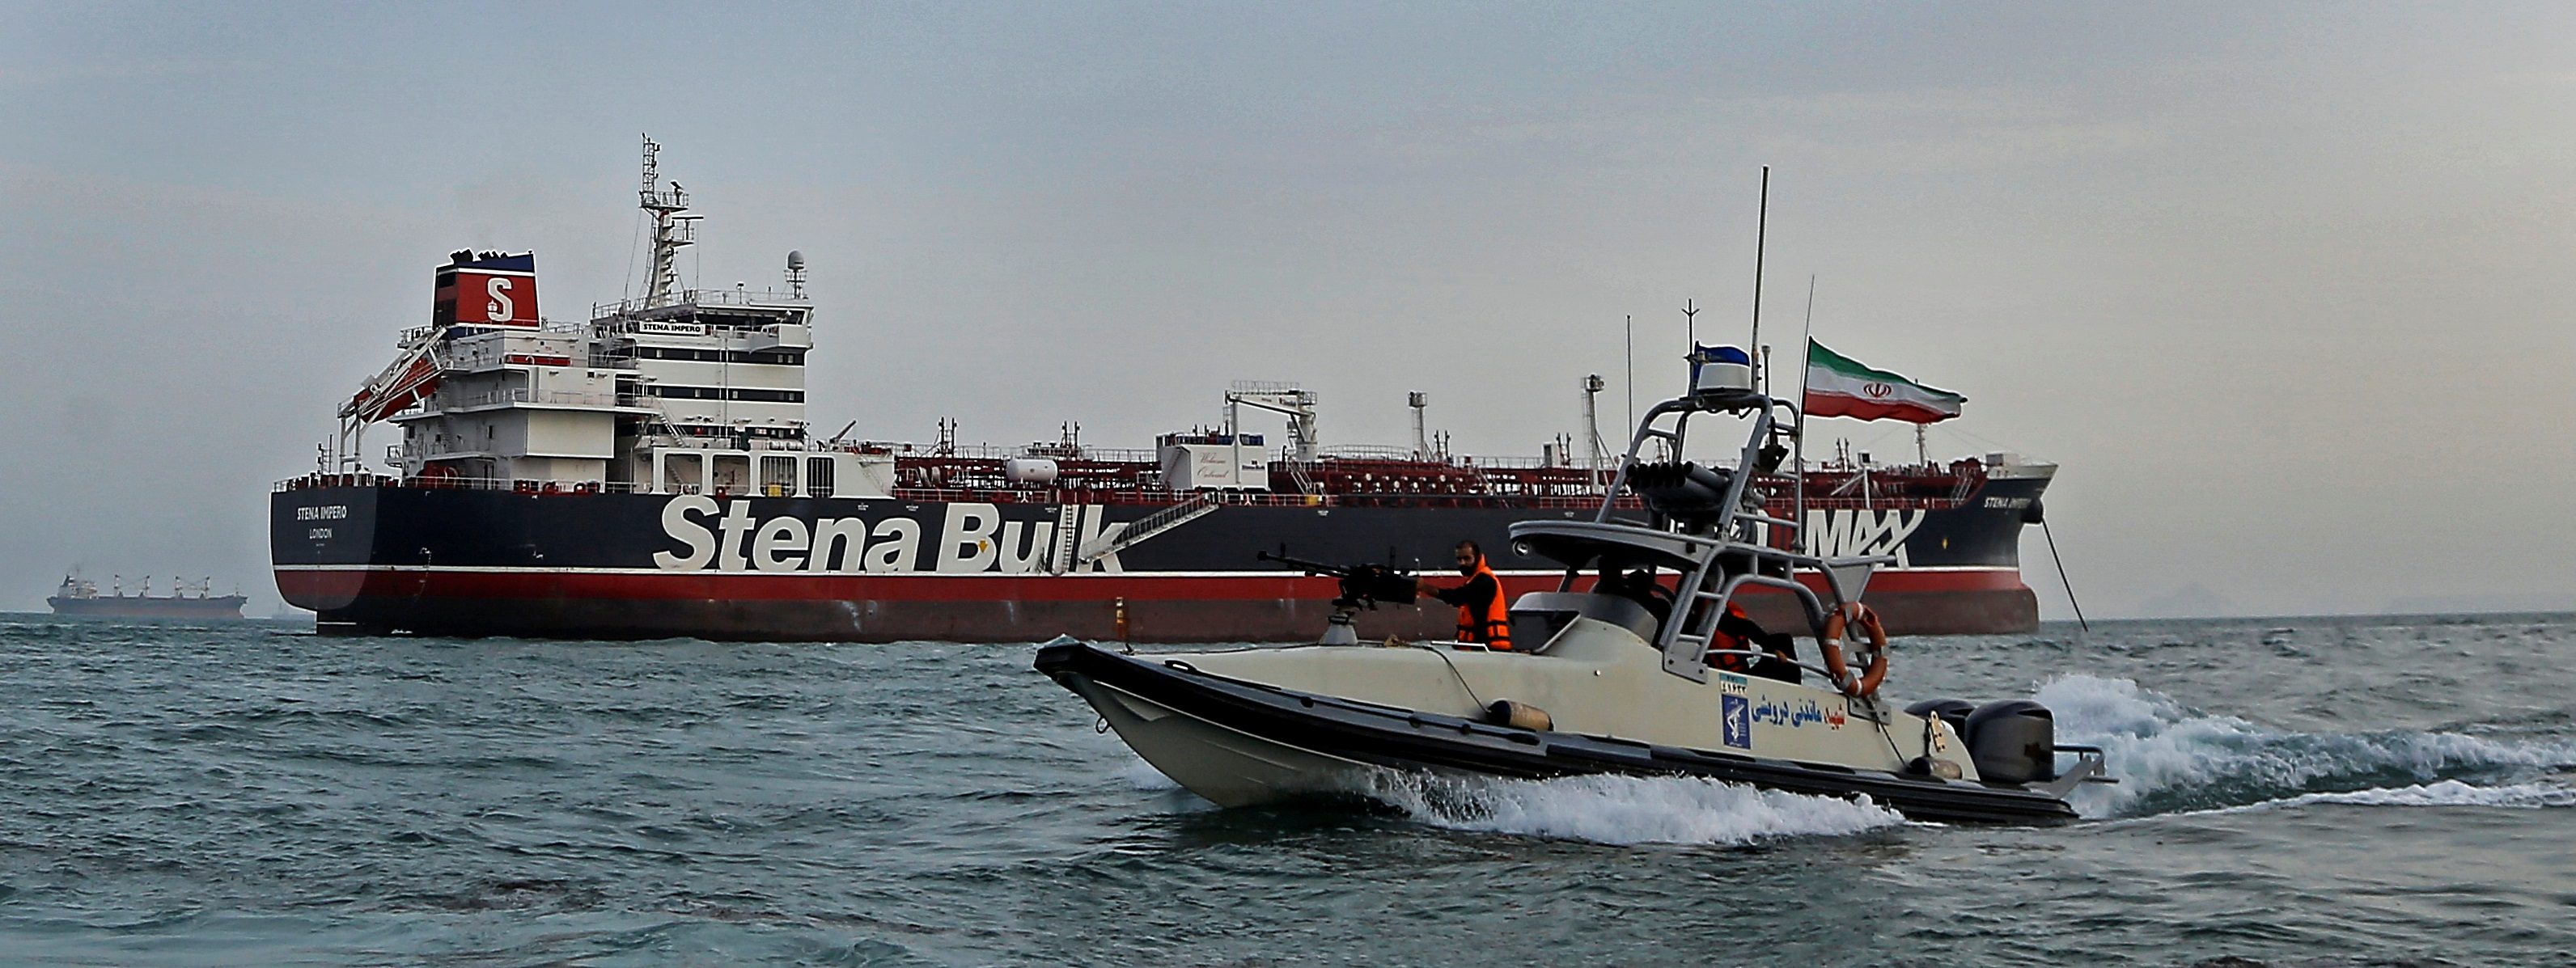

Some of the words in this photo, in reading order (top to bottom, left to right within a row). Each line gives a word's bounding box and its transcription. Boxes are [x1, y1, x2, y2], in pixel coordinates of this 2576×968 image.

[488, 277, 513, 322] S
[297, 506, 319, 521] STENA
[320, 505, 347, 519] IMPERO
[309, 528, 333, 539] LONDON
[653, 495, 921, 572] Stena
[936, 501, 1131, 572] Bulk
